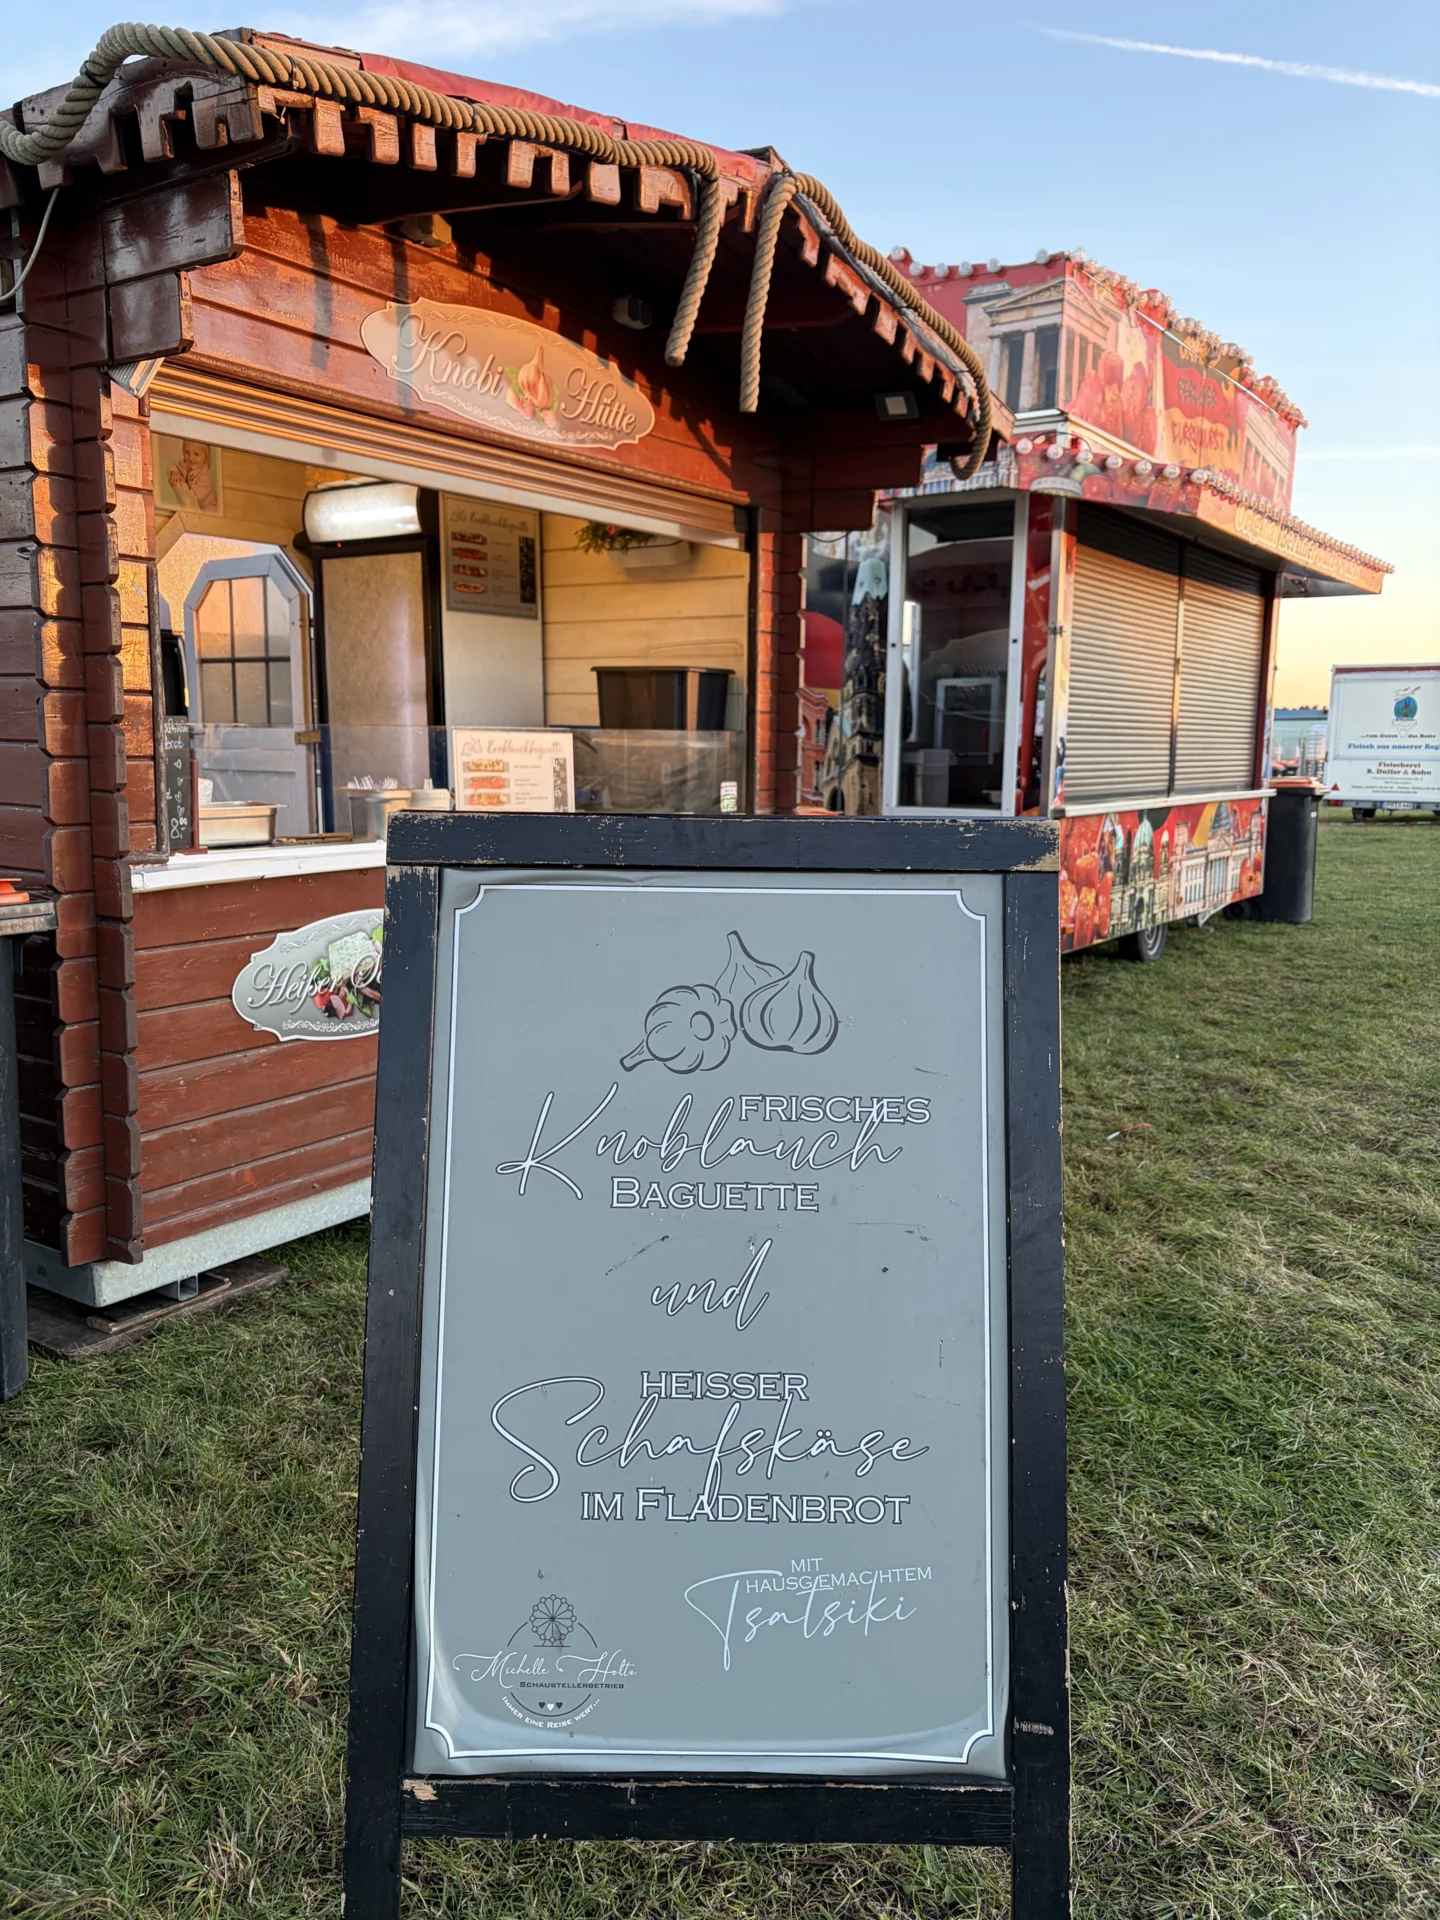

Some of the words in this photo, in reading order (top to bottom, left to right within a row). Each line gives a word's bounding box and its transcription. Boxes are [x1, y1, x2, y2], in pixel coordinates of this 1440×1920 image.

[392, 313, 503, 397] Knobi
[560, 366, 637, 434] Hütte
[1378, 761, 1421, 769] Fleischerei
[247, 961, 342, 1016] Heißer
[739, 1094, 931, 1125] FRISCHES
[496, 1081, 904, 1201] Knoblauch
[650, 1238, 772, 1332] und
[639, 1370, 810, 1401] HEISSER
[491, 1376, 930, 1504] Schafskäse
[581, 1491, 624, 1521] IM
[745, 1566, 933, 1594] HAUSGEMACHTEM
[790, 1557, 824, 1573] MIT
[684, 1569, 918, 1671] Tsatsiki
[452, 1650, 550, 1689] Michelle
